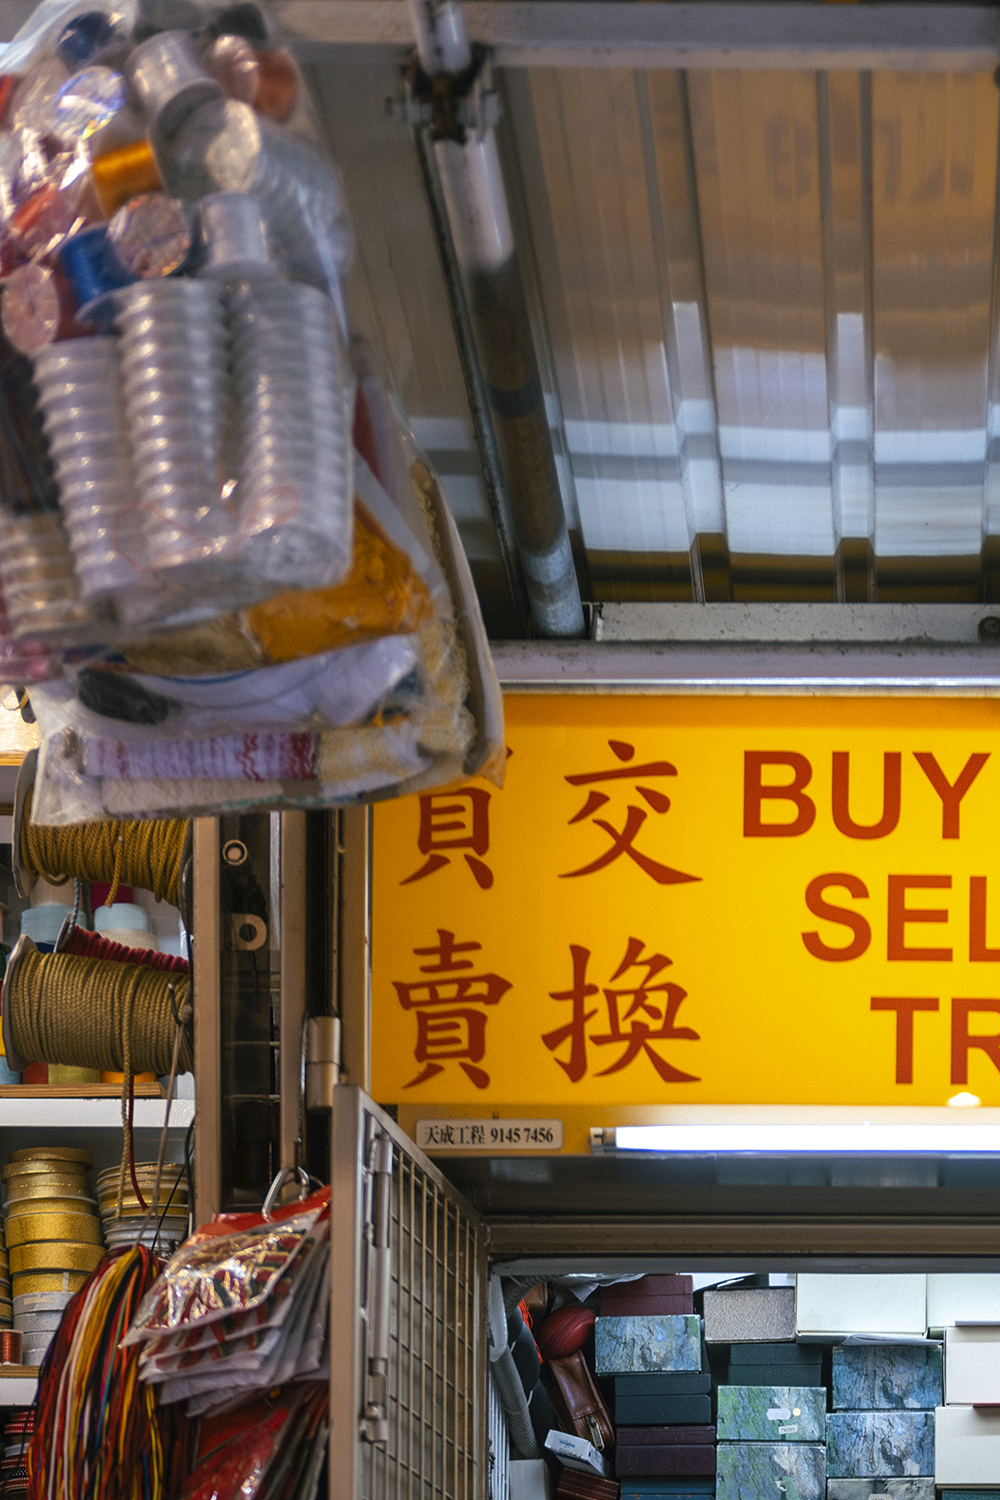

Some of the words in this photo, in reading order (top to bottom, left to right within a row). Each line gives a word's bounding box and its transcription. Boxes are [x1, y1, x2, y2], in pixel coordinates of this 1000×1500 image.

[743, 750, 991, 840] BUY
[424, 1125, 486, 1145] 天成工程
[491, 1127, 521, 1143] 9145
[524, 1127, 554, 1143] 7456
